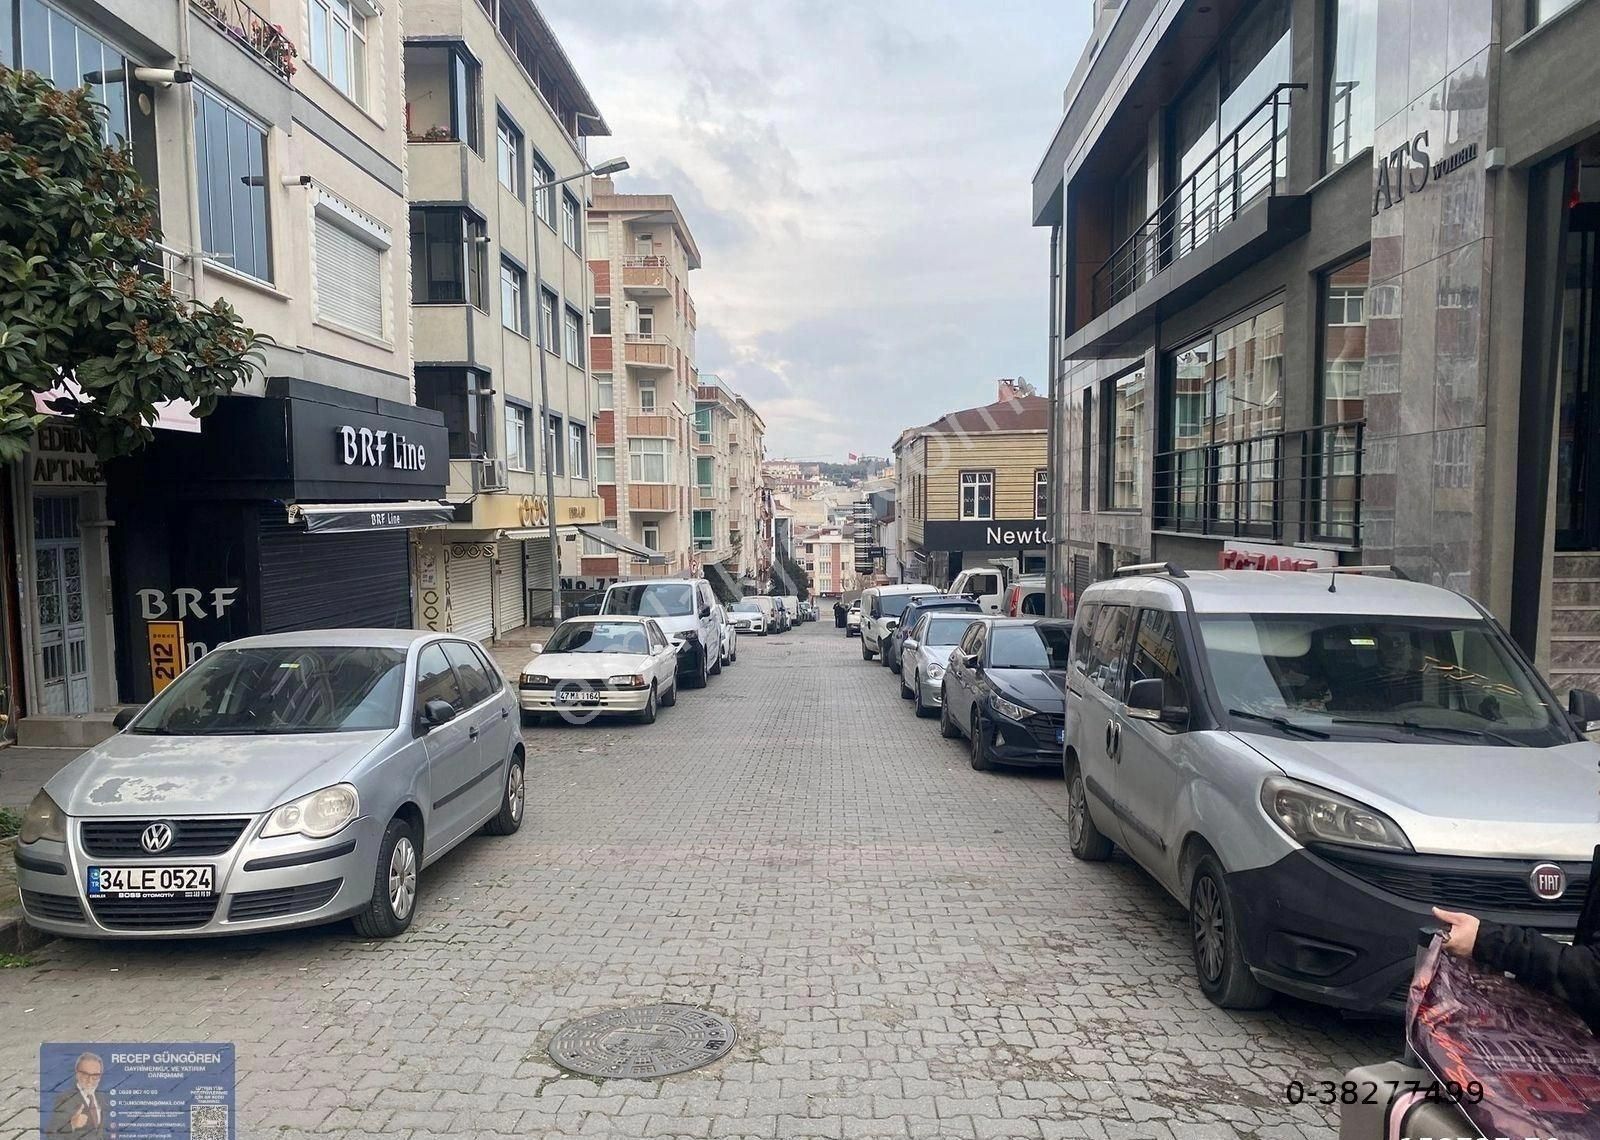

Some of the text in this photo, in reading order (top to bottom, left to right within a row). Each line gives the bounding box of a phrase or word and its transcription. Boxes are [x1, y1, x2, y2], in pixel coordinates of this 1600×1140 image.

[1371, 130, 1479, 217] ATS woman
[341, 425, 426, 471] BRF Line
[371, 513, 400, 526] BRF Line
[136, 587, 239, 619] BRF
[153, 643, 175, 680] 212
[1539, 874, 1559, 890] FIAT
